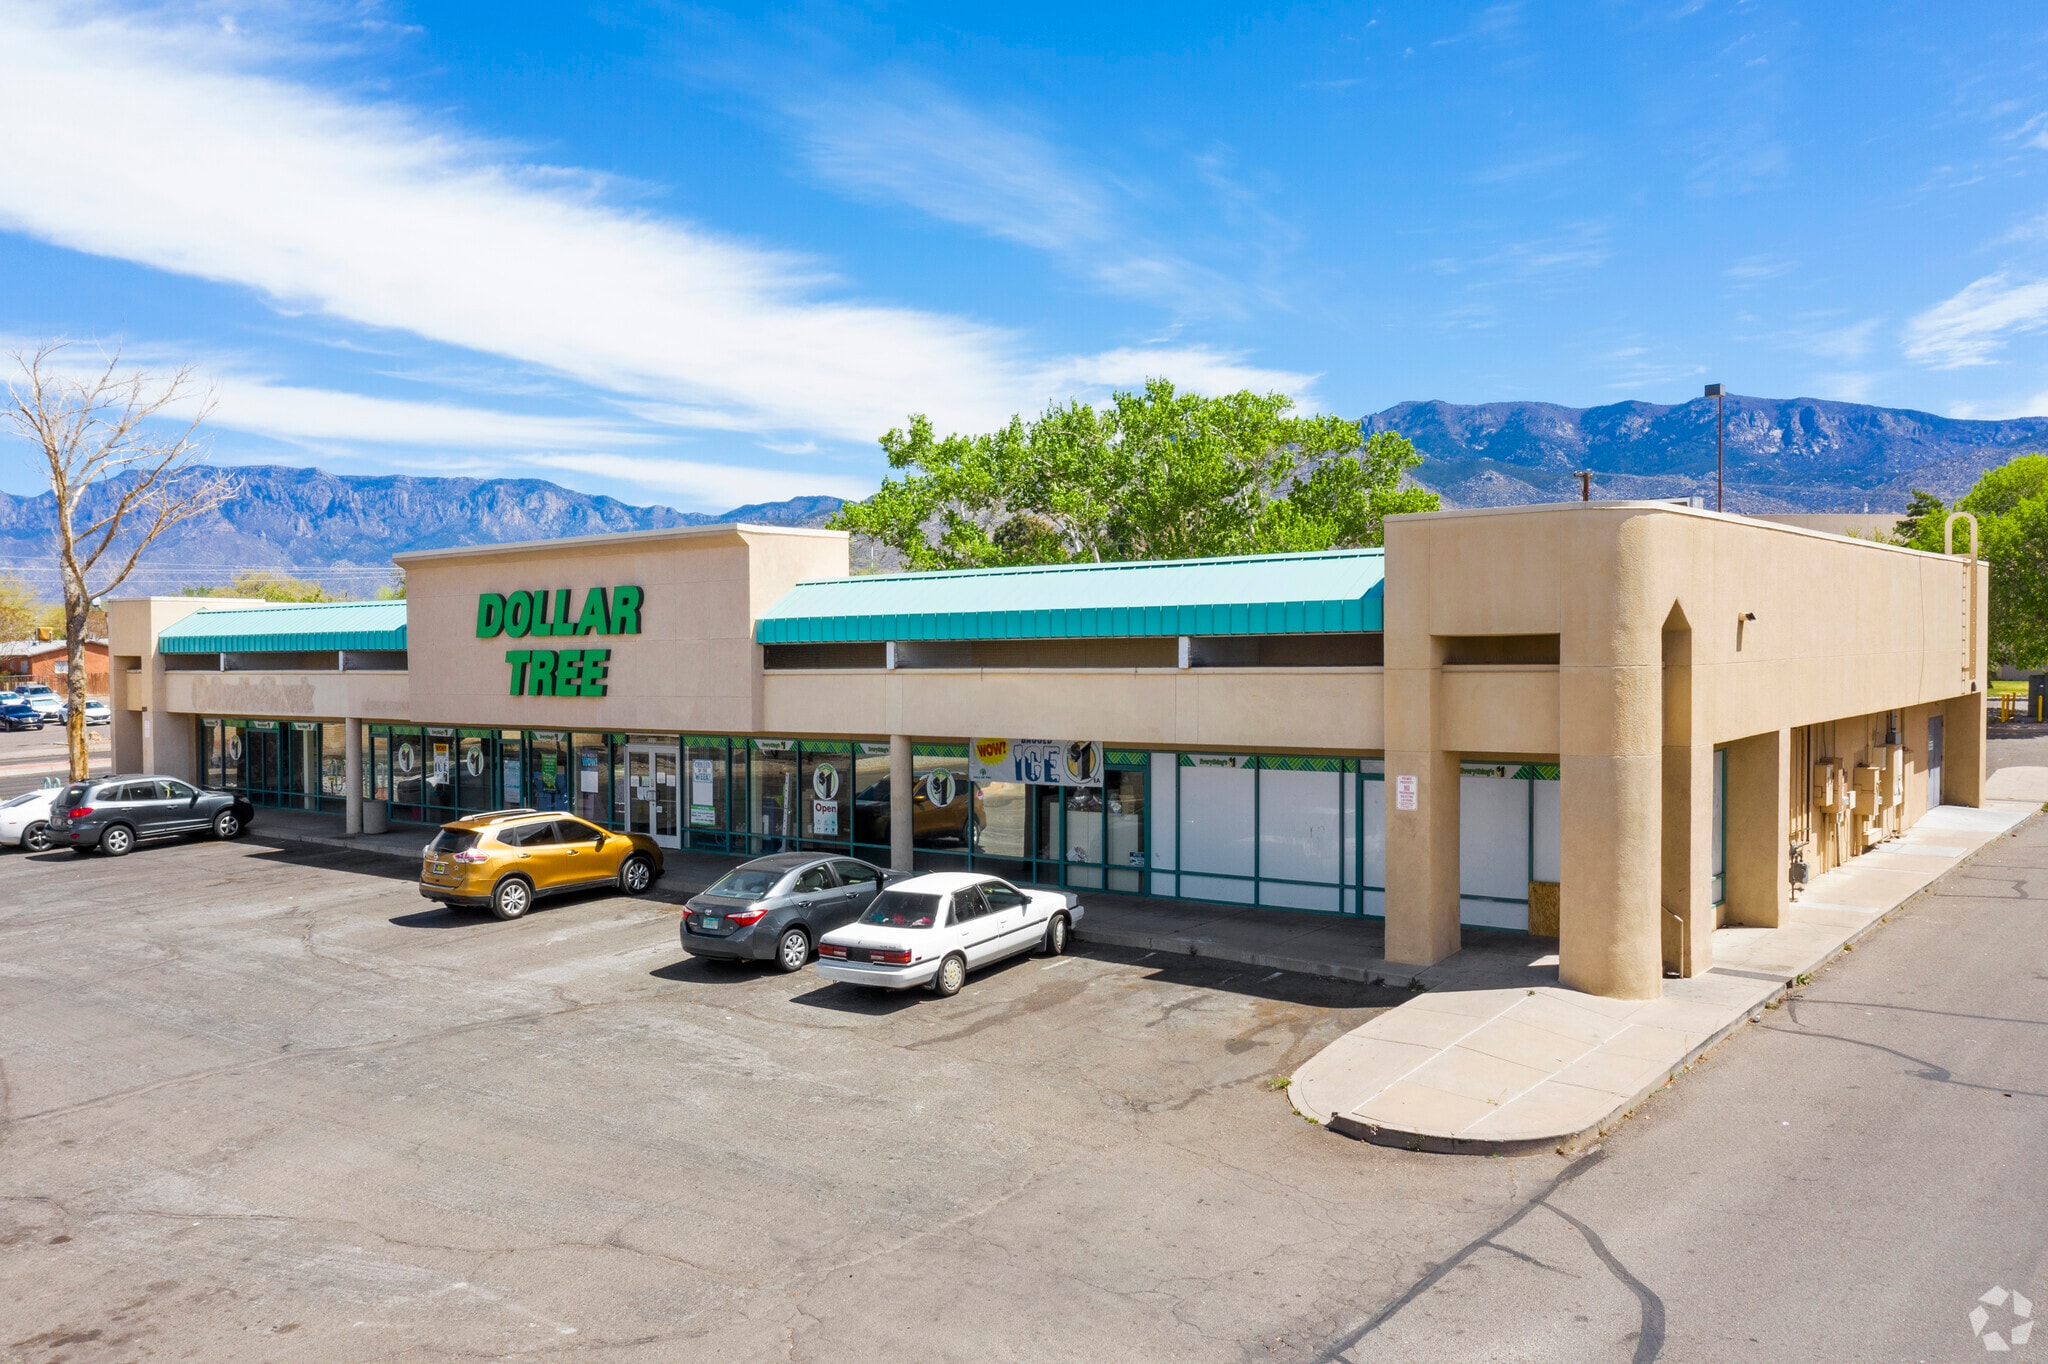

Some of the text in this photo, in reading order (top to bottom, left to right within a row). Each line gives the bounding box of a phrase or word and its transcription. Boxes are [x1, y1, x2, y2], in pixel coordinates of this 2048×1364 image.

[476, 585, 644, 638] DOLLAR
[505, 649, 611, 697] TREE
[977, 742, 1007, 757] WOW!
[1013, 745, 1060, 783] ICE
[1200, 758, 1228, 767] Everything's
[817, 770, 832, 799] $1
[931, 776, 948, 805] $1
[815, 802, 837, 814] Open
